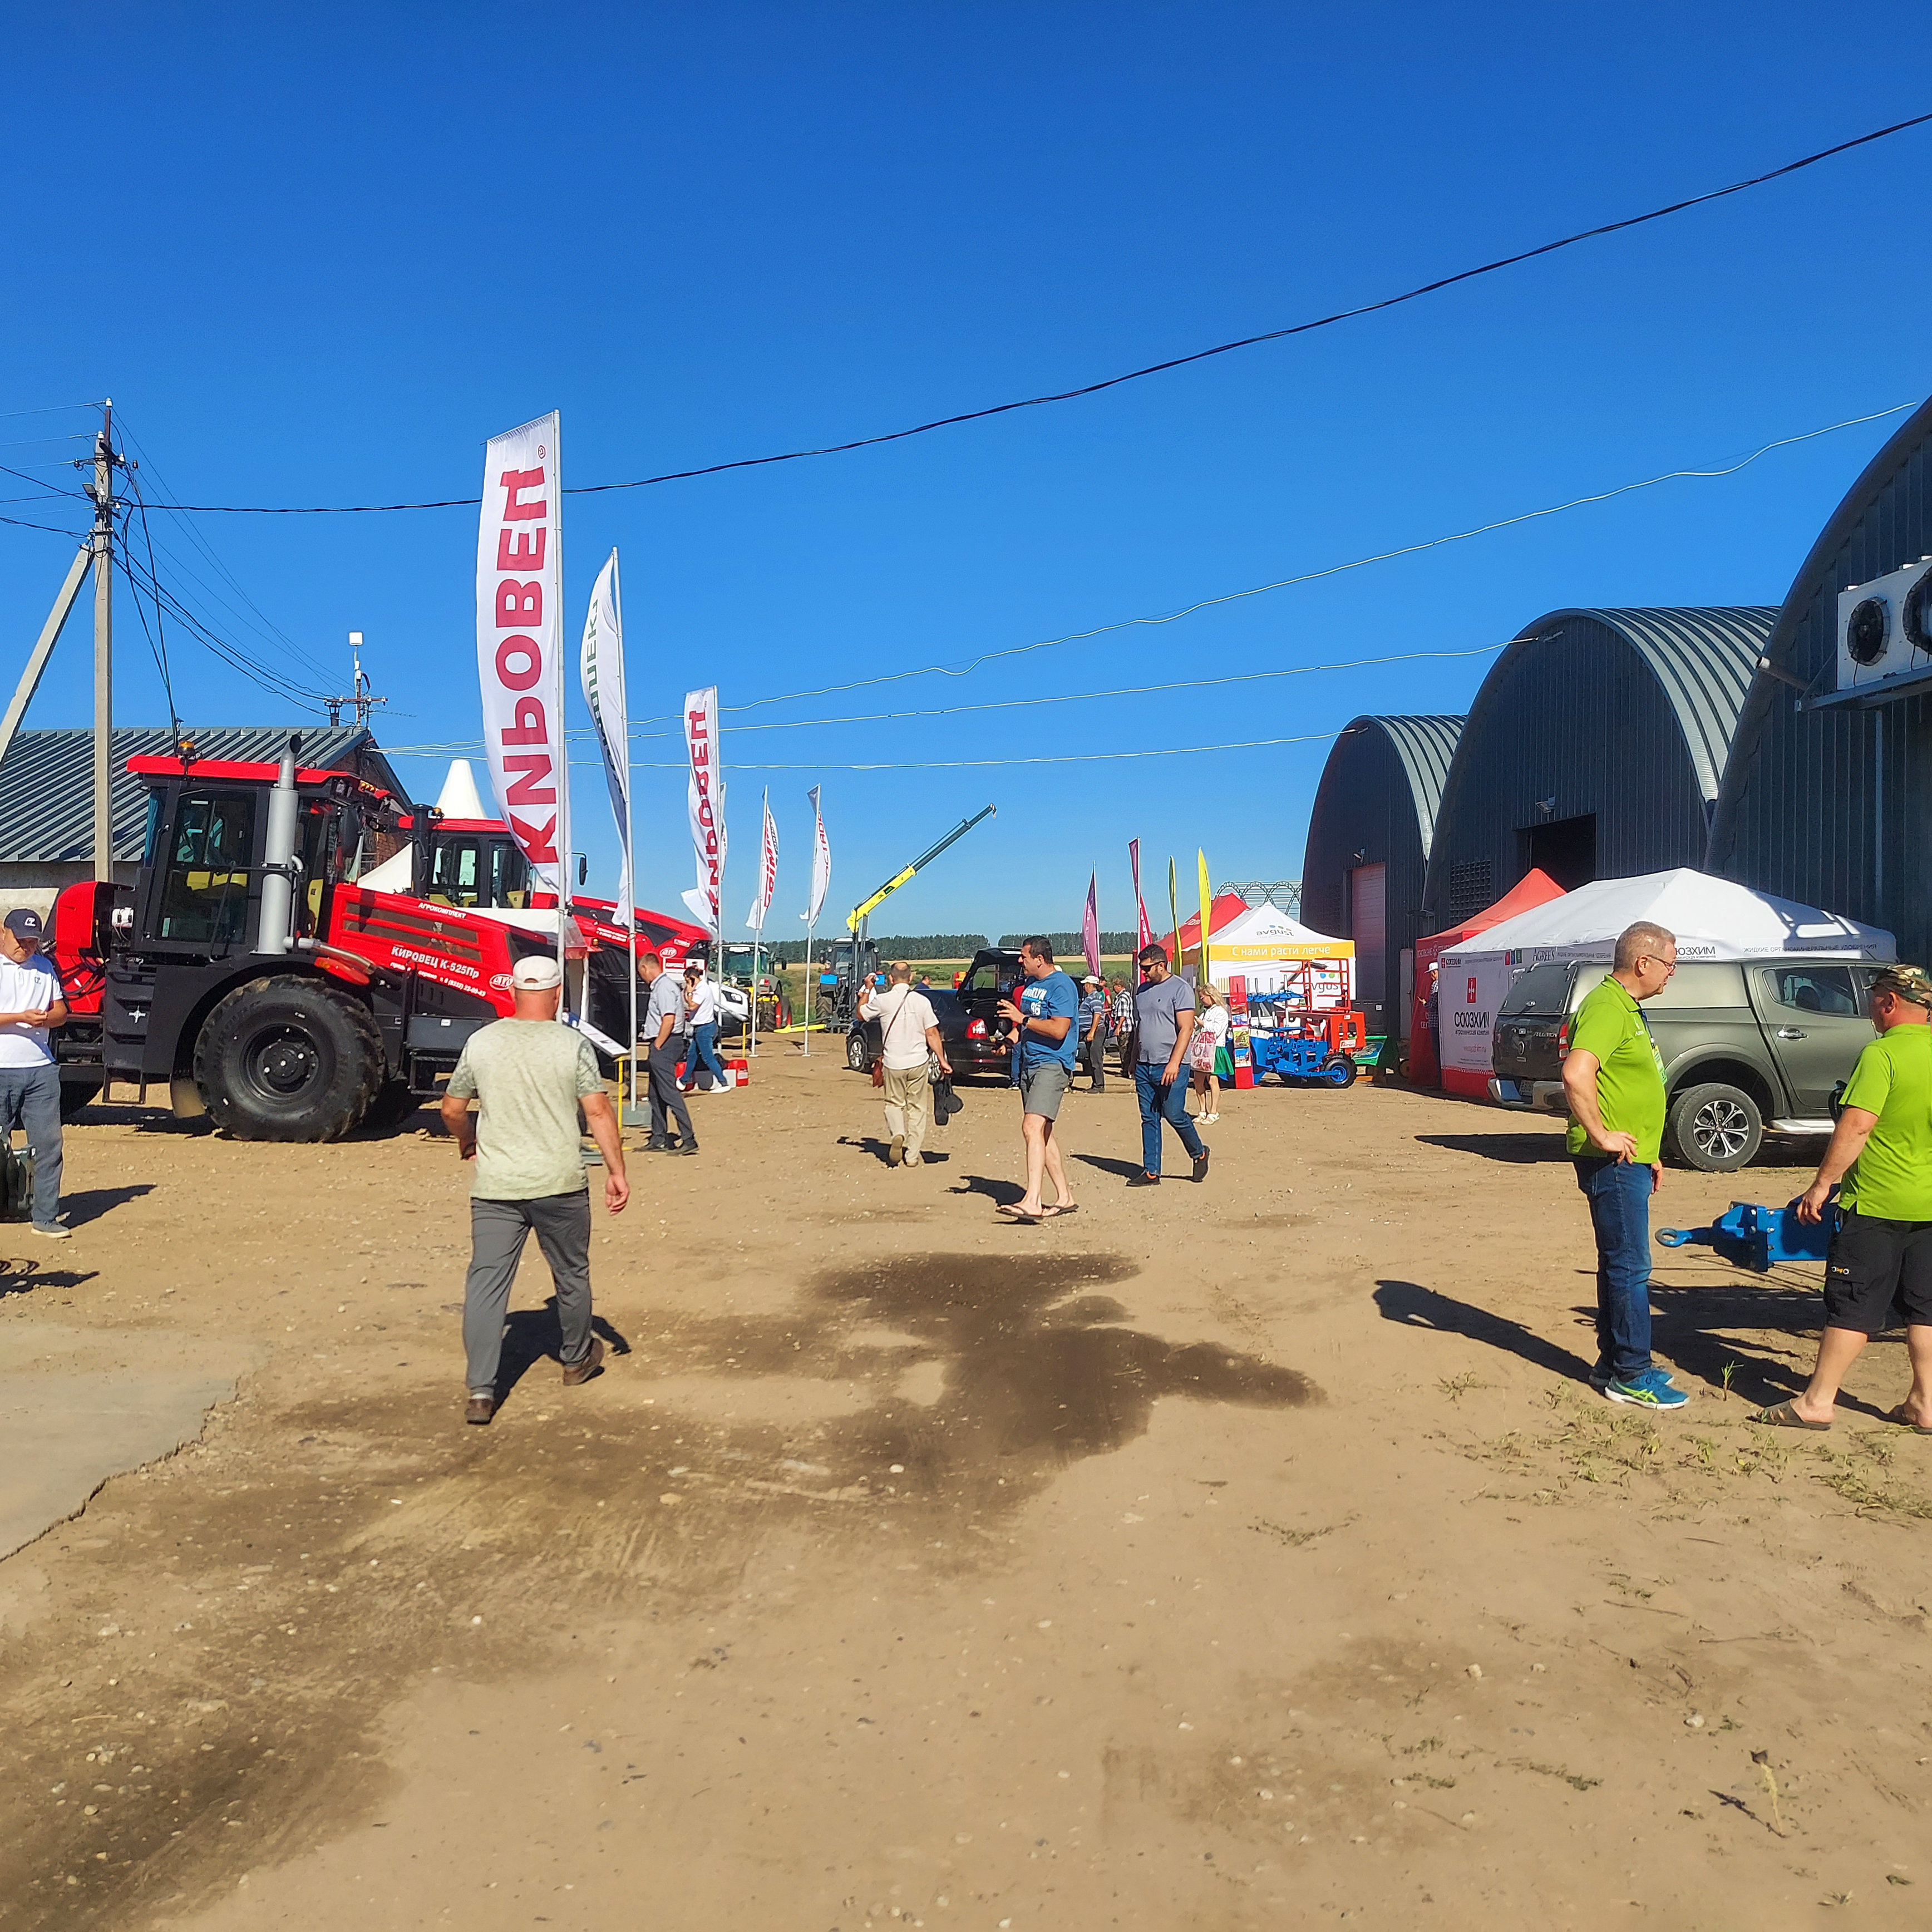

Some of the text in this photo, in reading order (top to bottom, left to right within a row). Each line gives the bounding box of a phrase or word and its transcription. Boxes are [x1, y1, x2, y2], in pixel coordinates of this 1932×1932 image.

[391, 946, 438, 968] КИРОВЕЦ
[1232, 946, 1330, 958] С нами расти легче
[1675, 947, 1716, 955] ЮЗХИМ
[1305, 982, 1339, 993] vgus
[1454, 1011, 1490, 1028] СОЮЗХИМ
